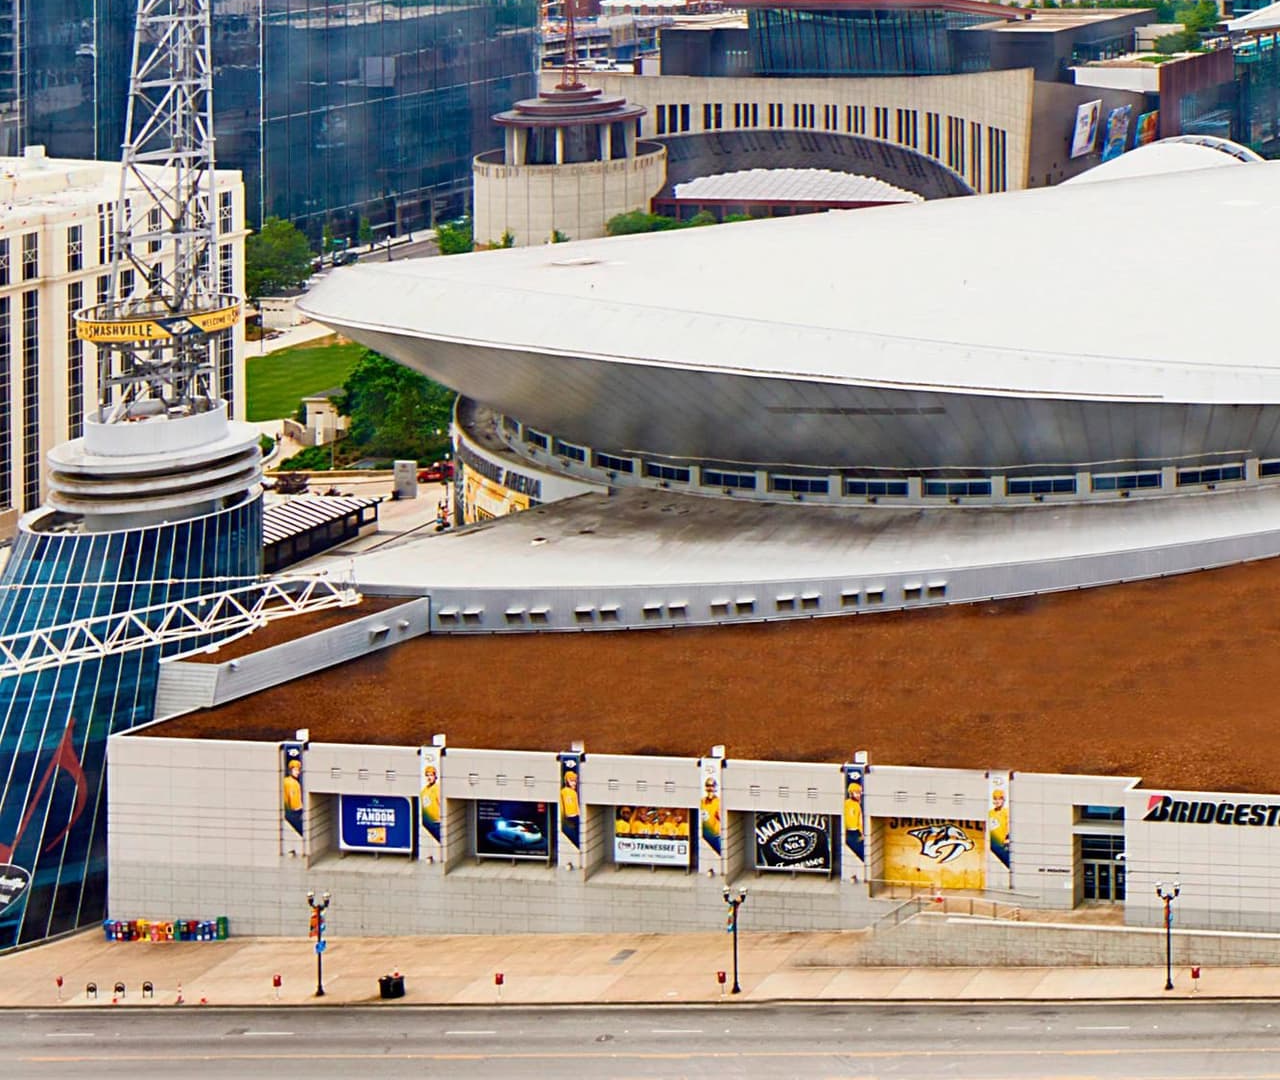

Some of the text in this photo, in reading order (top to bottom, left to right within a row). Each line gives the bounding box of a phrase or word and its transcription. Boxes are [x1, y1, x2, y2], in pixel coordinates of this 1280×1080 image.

[88, 324, 152, 338] SMASHVILLE
[755, 818, 783, 845] JACK
[637, 843, 675, 852] TENNESSEE
